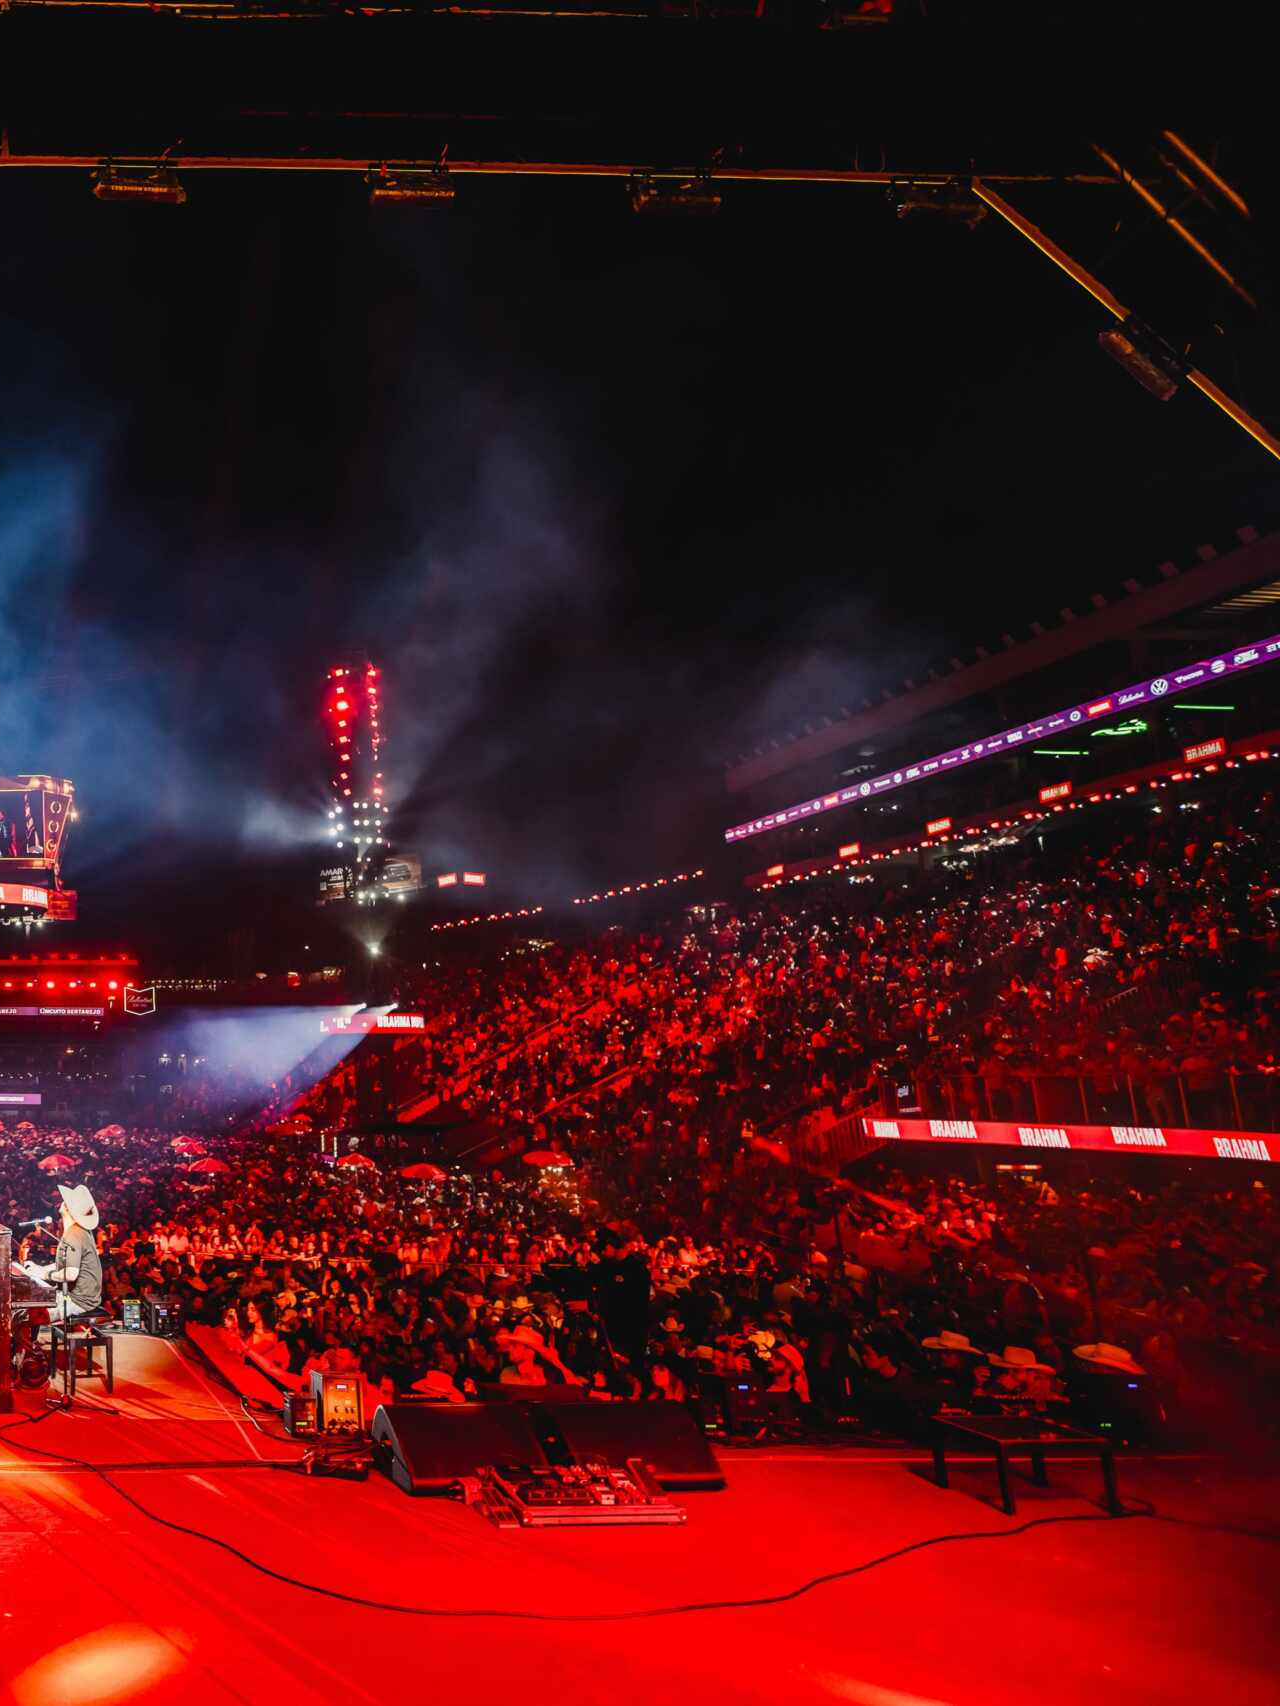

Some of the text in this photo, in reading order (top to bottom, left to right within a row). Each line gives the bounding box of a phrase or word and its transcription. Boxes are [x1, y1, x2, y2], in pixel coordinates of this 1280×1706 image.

[1186, 741, 1223, 761] BRAHMA
[928, 1120, 977, 1139] BRAHMA
[1017, 1127, 1071, 1149] BRAHMA
[1111, 1127, 1167, 1146] BRAHMA
[1213, 1137, 1271, 1161] BRAHMA
